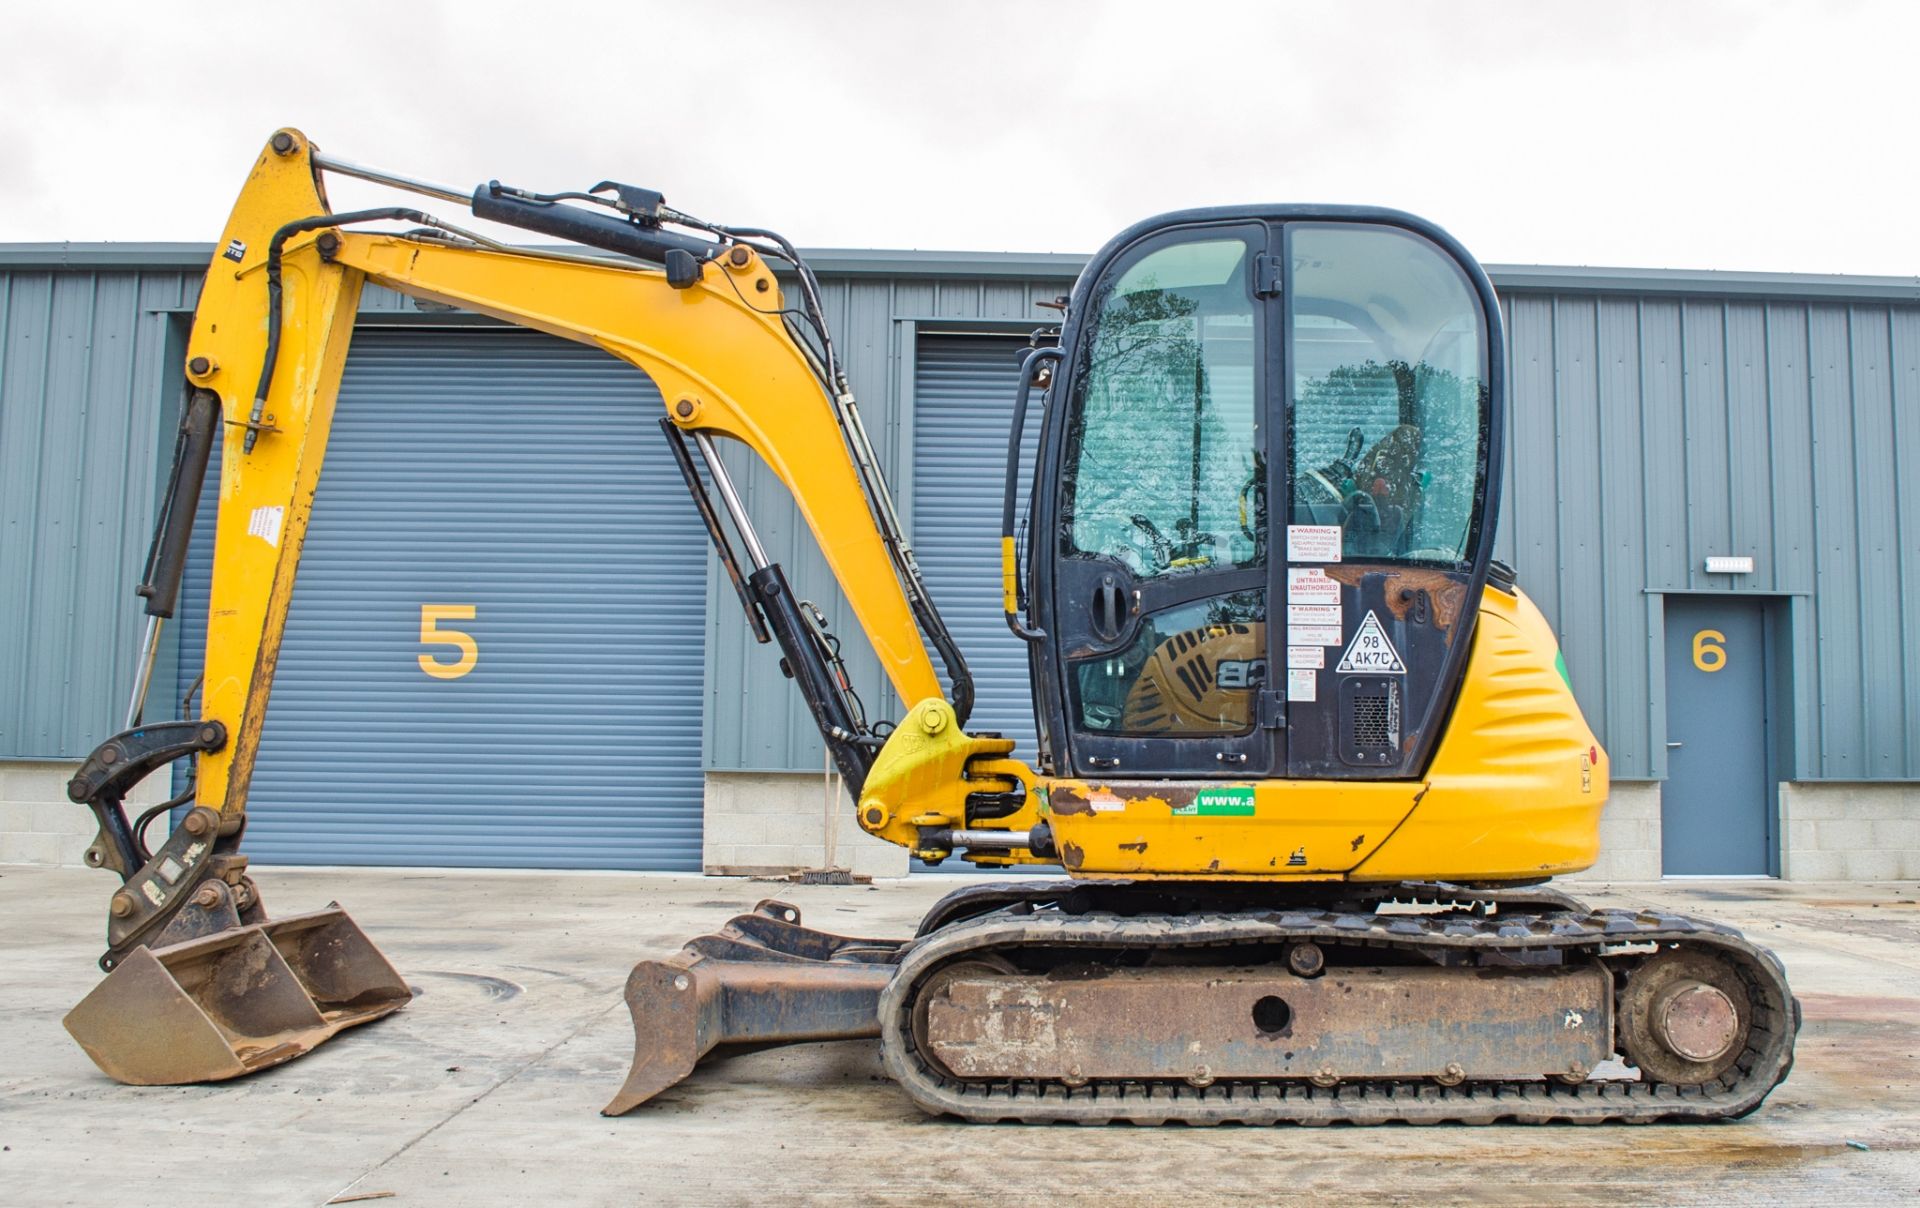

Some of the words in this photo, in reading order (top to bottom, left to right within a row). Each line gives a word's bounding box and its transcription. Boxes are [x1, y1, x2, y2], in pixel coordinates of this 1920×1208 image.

[417, 604, 479, 679] 5
[1363, 636, 1379, 648] 98
[1693, 630, 1726, 672] 6
[1355, 652, 1389, 664] AK7C
[1201, 796, 1254, 806] www.a
